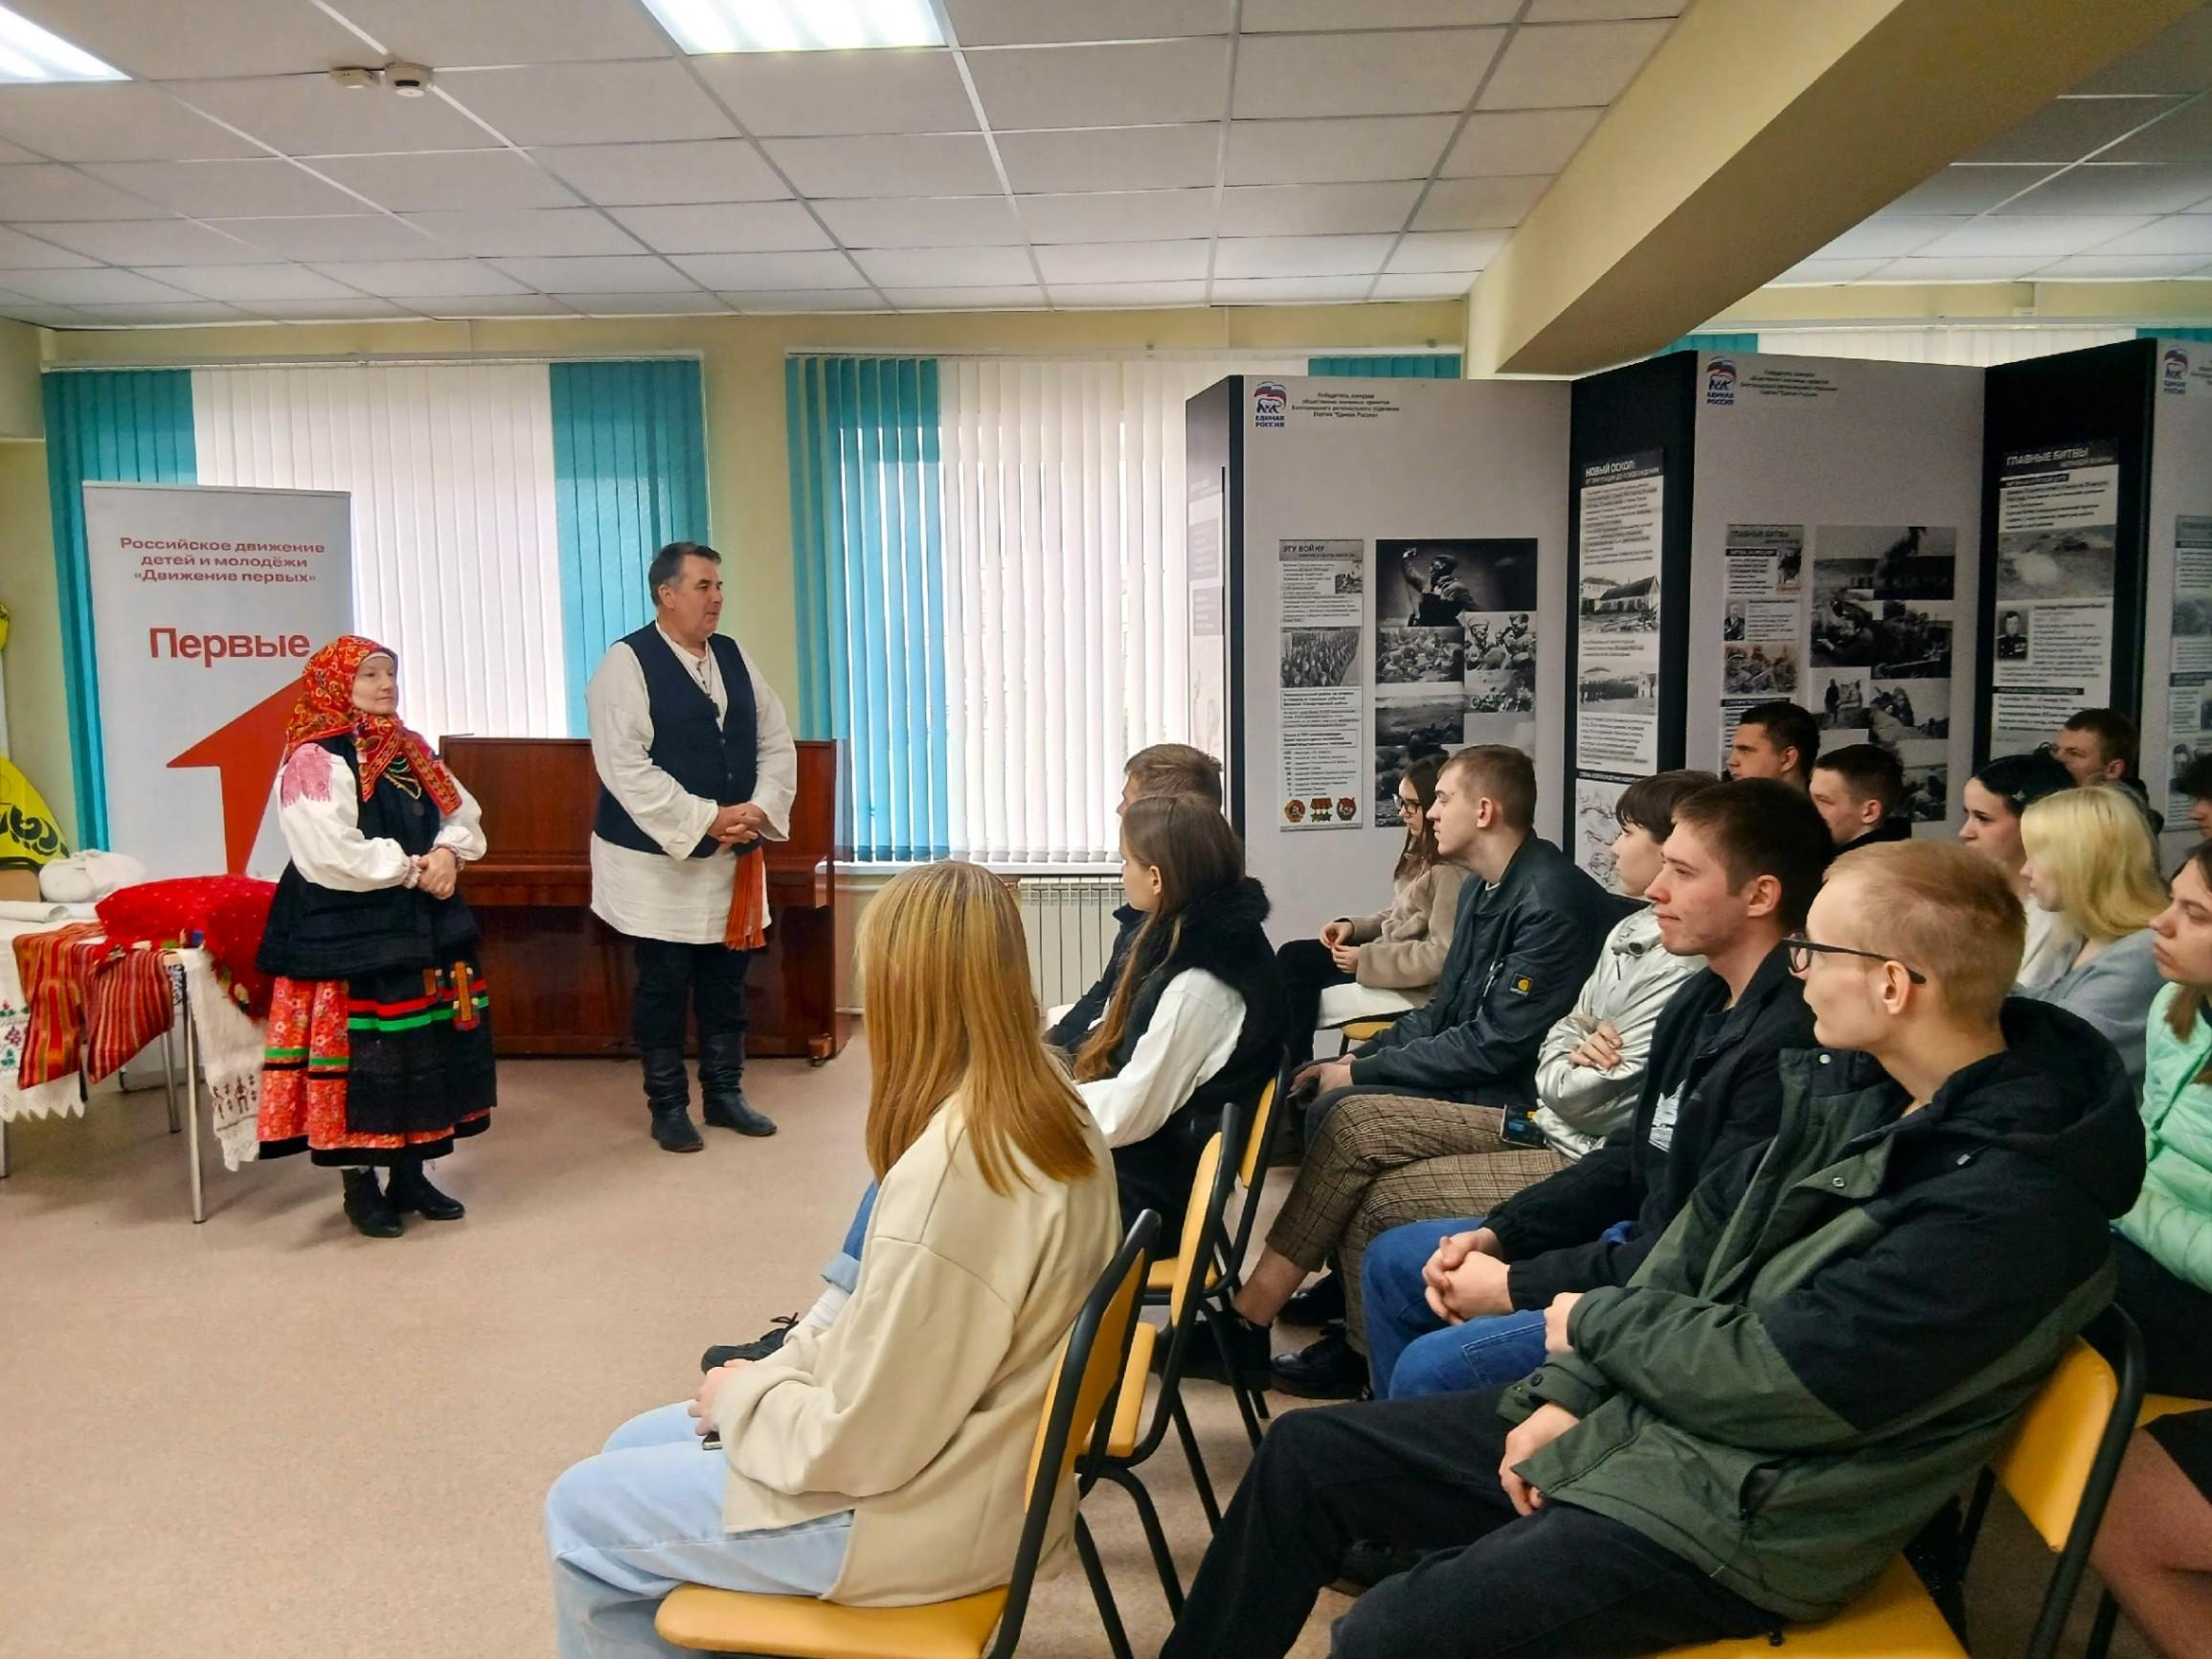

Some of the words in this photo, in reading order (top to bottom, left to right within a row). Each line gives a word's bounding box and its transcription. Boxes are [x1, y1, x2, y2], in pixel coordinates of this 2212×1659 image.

[1585, 465, 1610, 477] НОВЫЙ
[120, 536, 232, 552] Российское
[235, 542, 326, 554] движение
[141, 554, 195, 567] детей
[199, 557, 210, 566] и
[214, 556, 307, 568] молодёжи
[133, 569, 238, 582] «Движение
[241, 572, 317, 584] первых»
[149, 627, 310, 668] Первые
